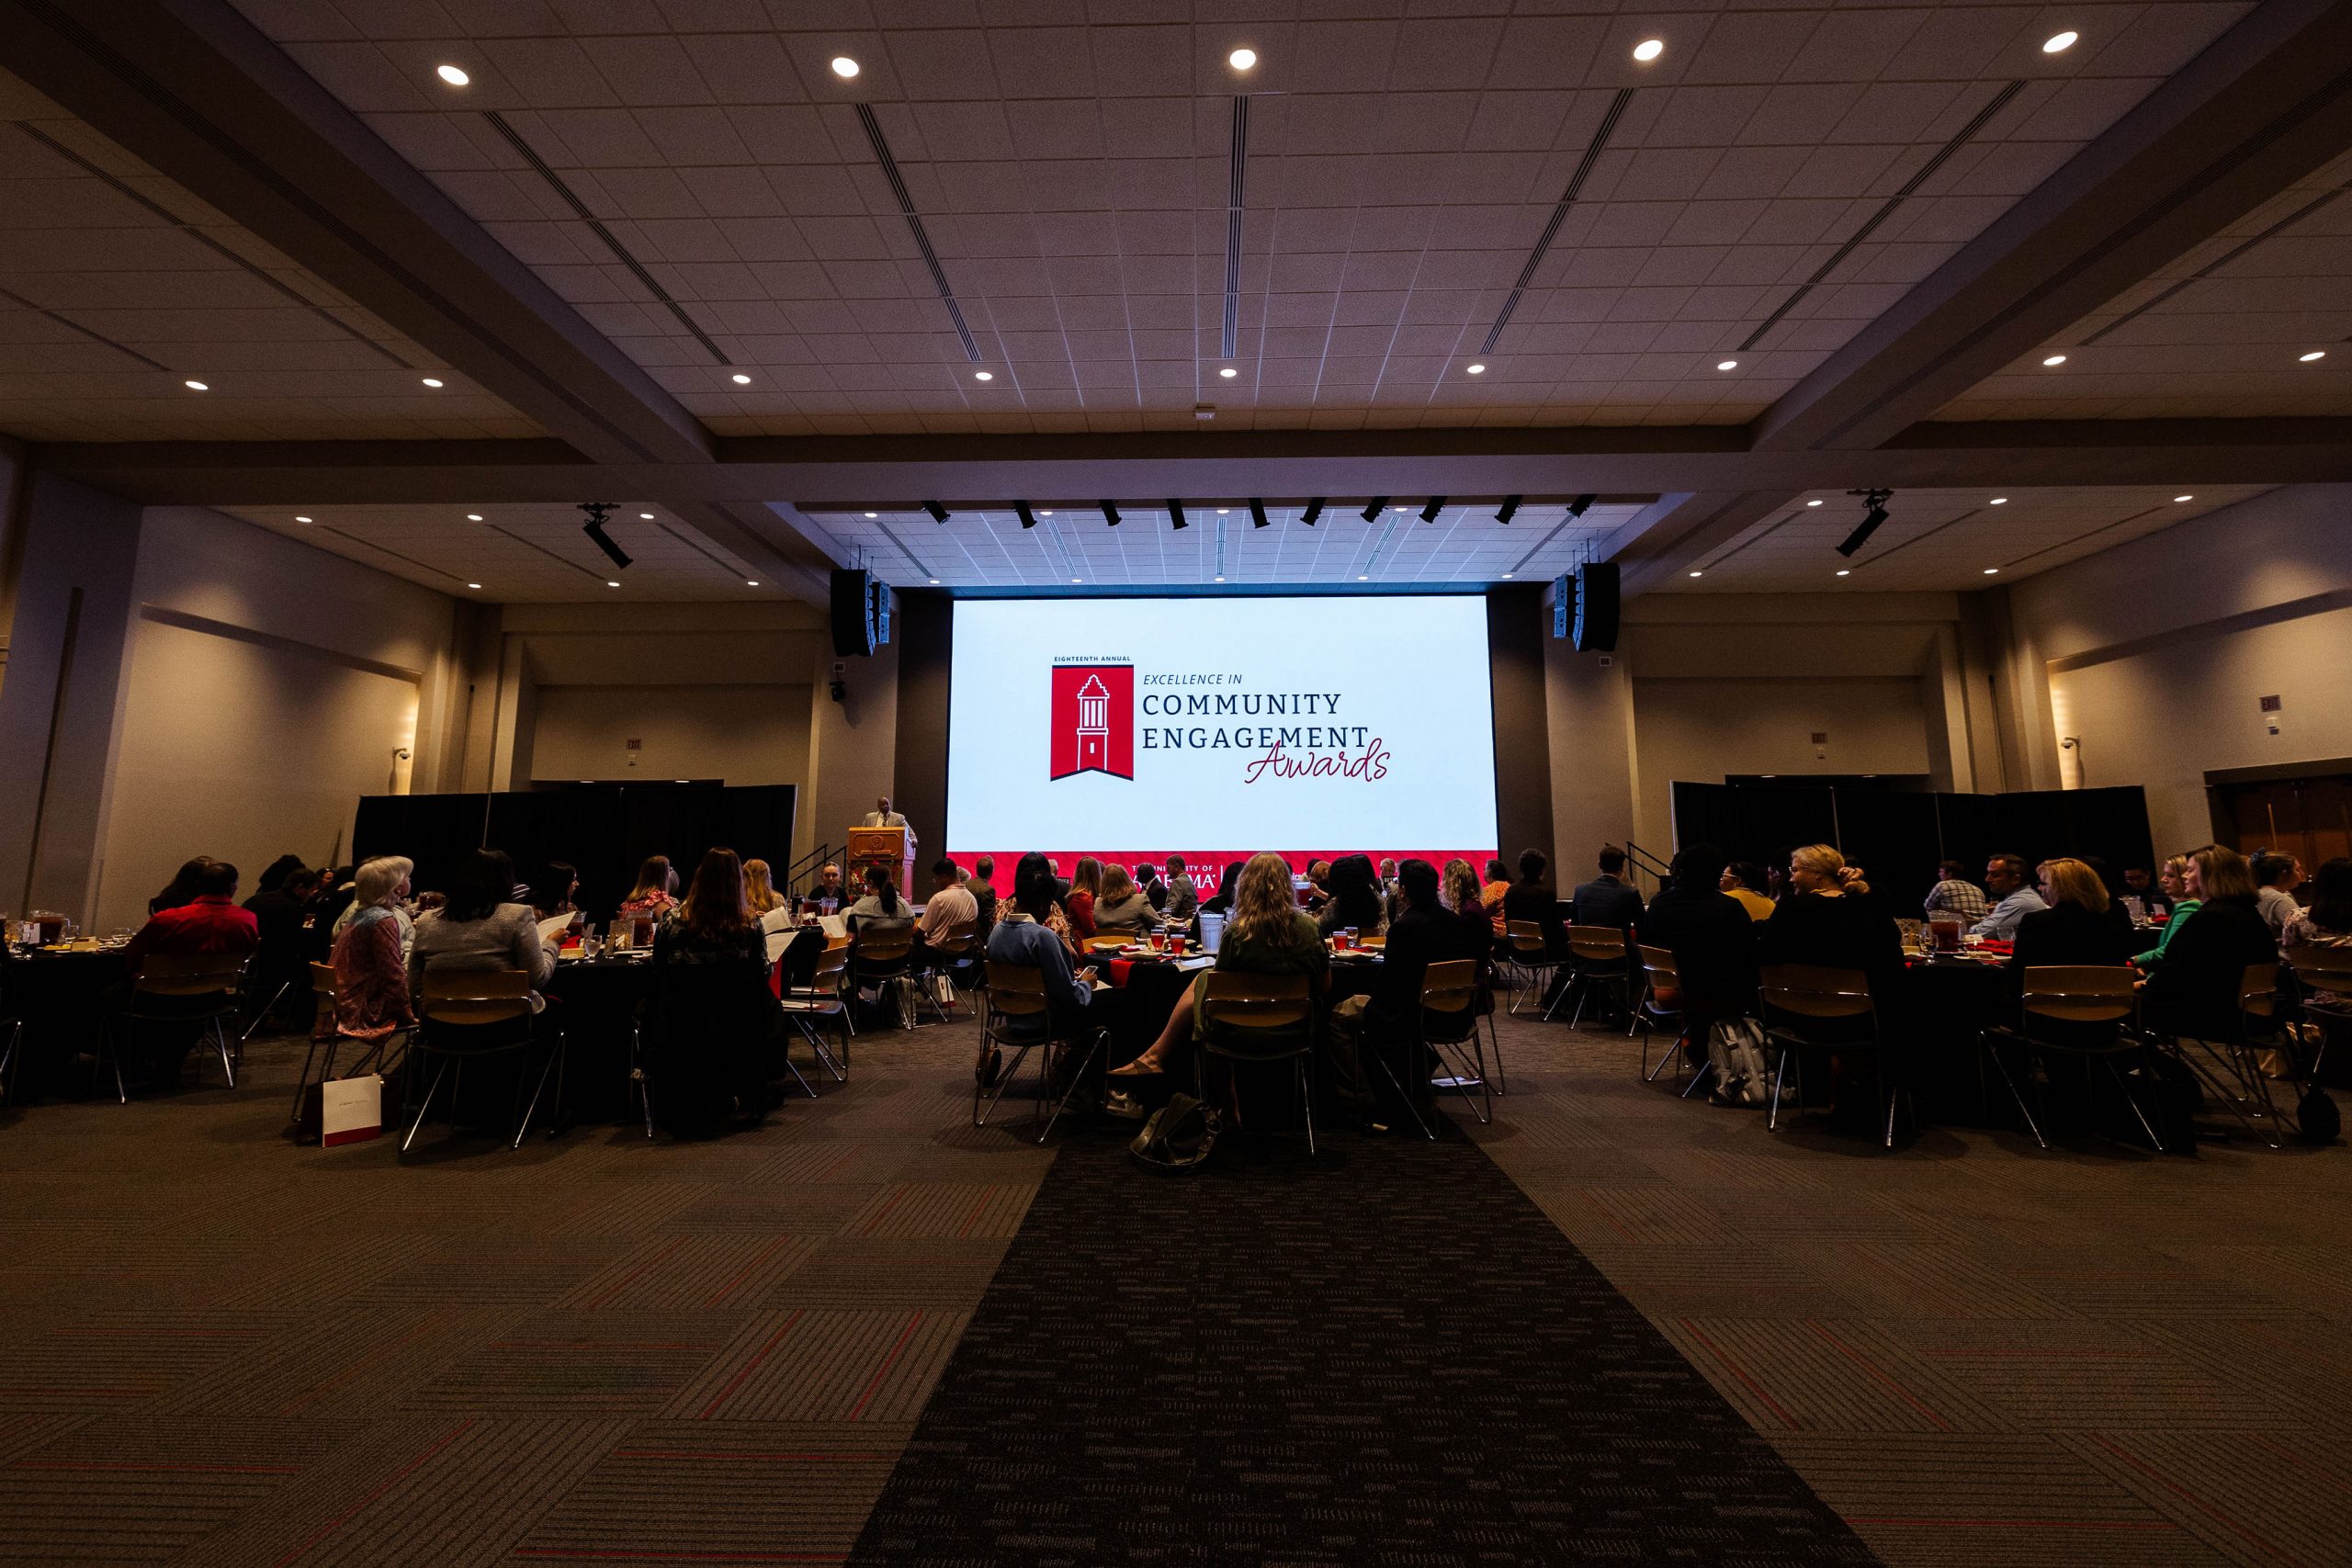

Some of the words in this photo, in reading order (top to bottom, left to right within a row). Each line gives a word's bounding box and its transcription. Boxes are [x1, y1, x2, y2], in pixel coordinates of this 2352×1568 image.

[1143, 673, 1223, 685] EXCELLENCE
[1227, 673, 1242, 684] IN
[1142, 694, 1341, 716] COMMUNITY
[1142, 727, 1369, 749] ENGAGEMENT
[1244, 738, 1390, 784] Awards
